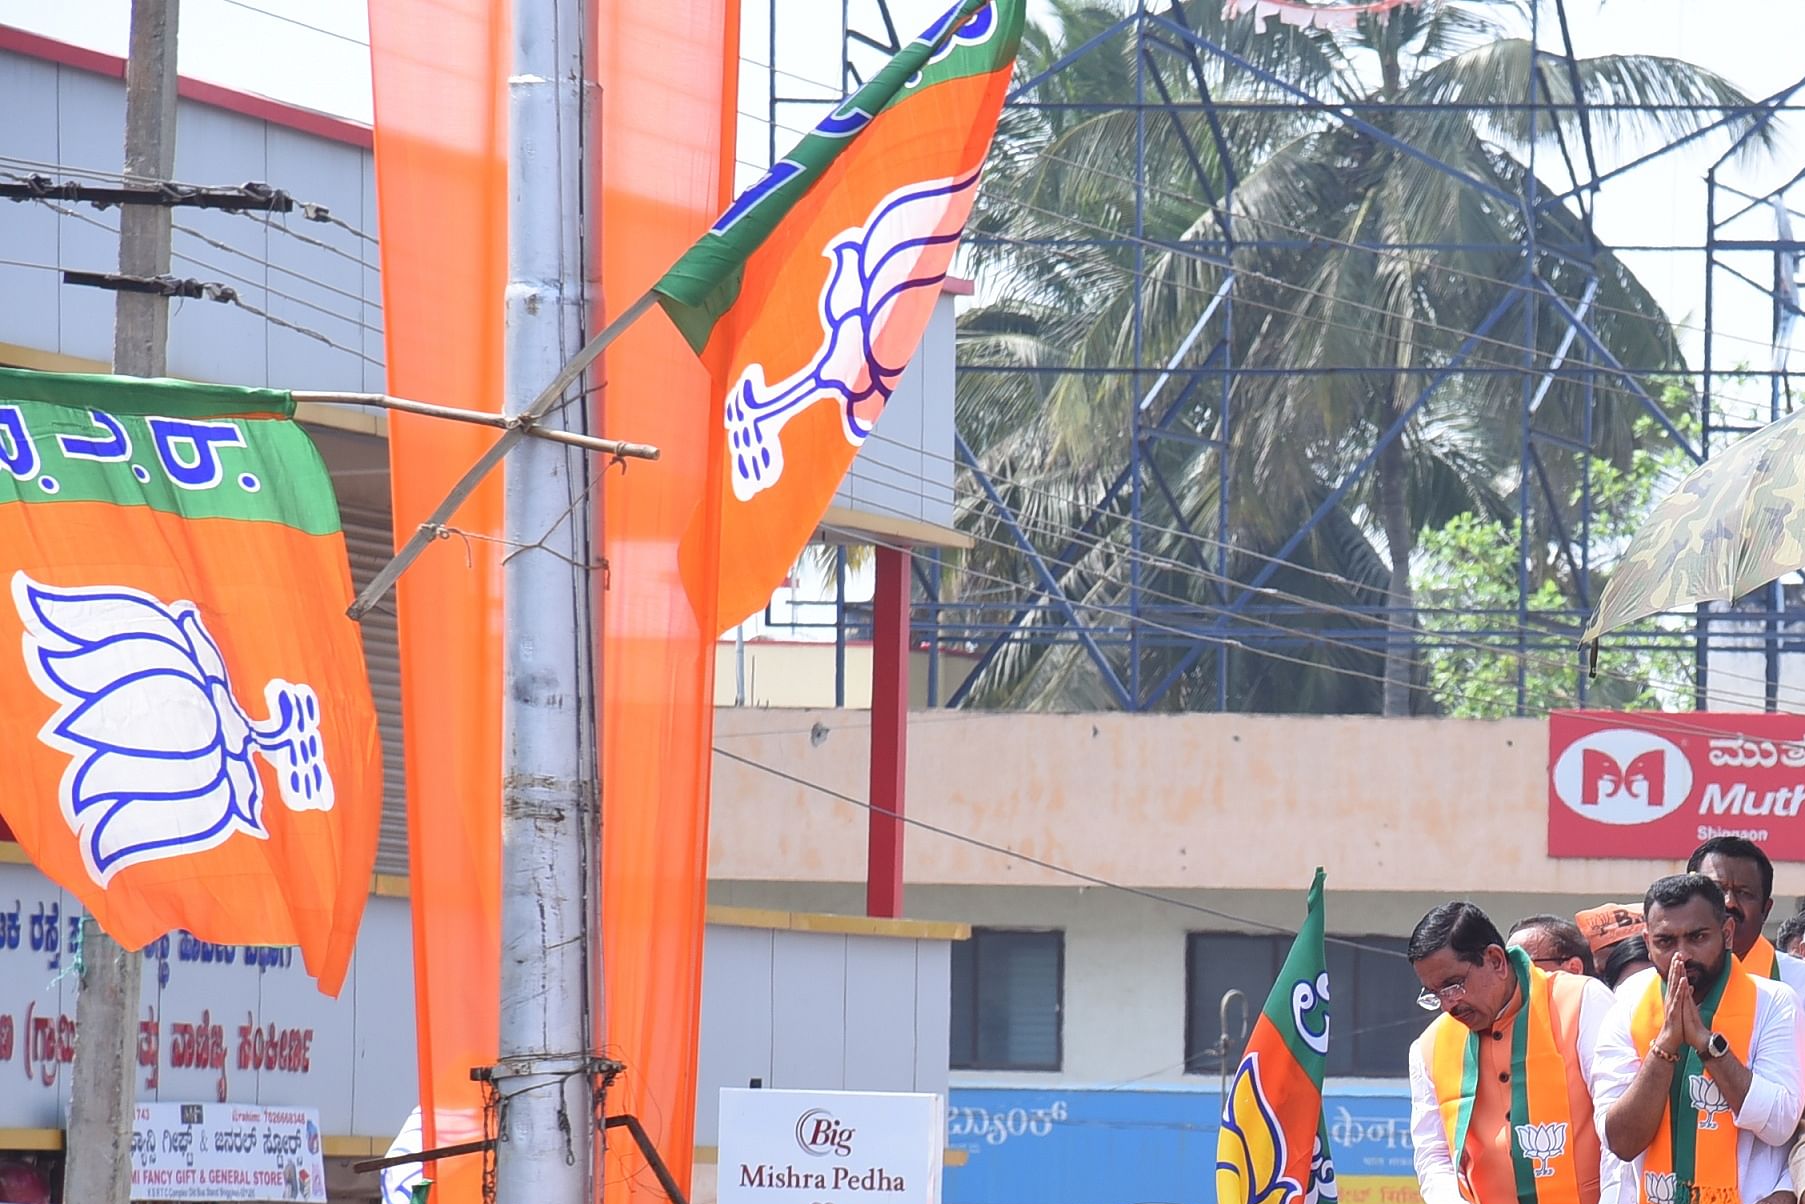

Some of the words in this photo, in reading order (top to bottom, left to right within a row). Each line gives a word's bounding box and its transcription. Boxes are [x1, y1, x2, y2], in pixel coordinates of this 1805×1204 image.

[809, 1118, 856, 1157] Big
[143, 1169, 172, 1185] FANCY
[176, 1169, 197, 1184] GIFT
[208, 1170, 251, 1186] GENERAL
[739, 1163, 827, 1190] Mishra
[832, 1166, 906, 1193] Pedha
